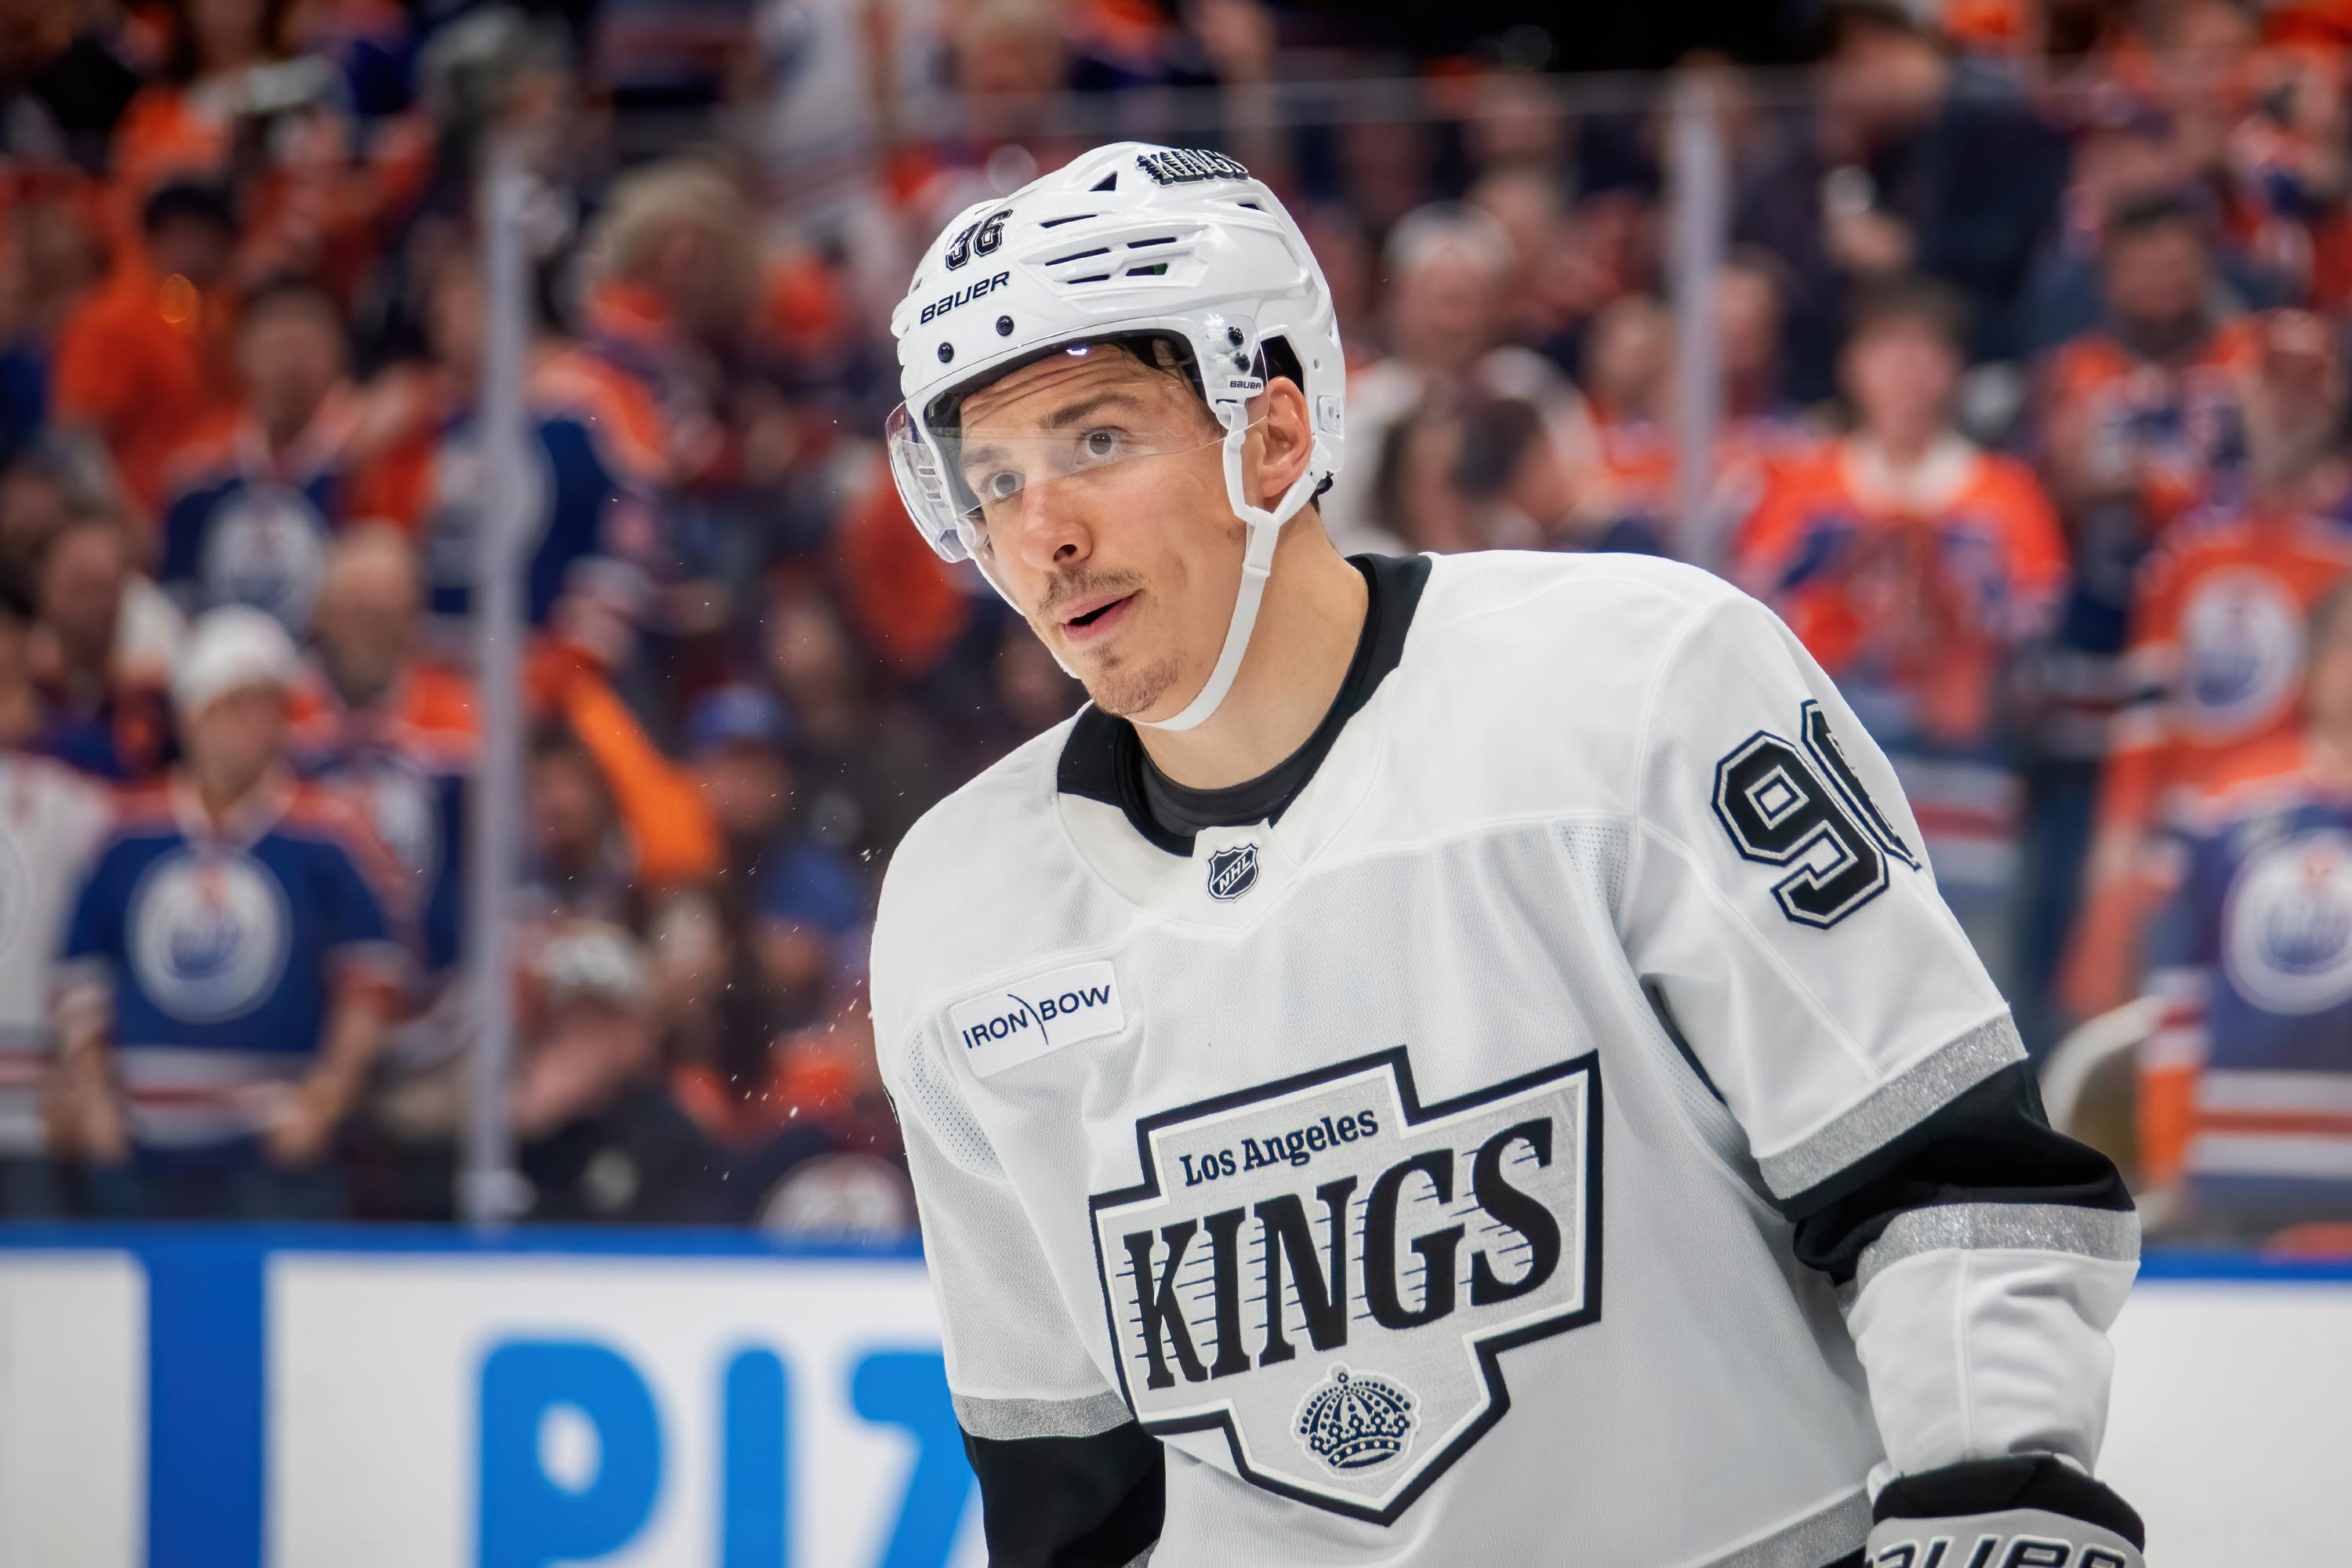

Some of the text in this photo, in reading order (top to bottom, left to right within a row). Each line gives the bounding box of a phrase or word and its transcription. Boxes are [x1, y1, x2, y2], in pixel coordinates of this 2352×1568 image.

[1219, 856, 1250, 893] NHL
[962, 985, 1110, 1050] IRON BOW
[1179, 1109, 1379, 1187] Los Angeles
[1120, 1116, 1562, 1390] KINGS
